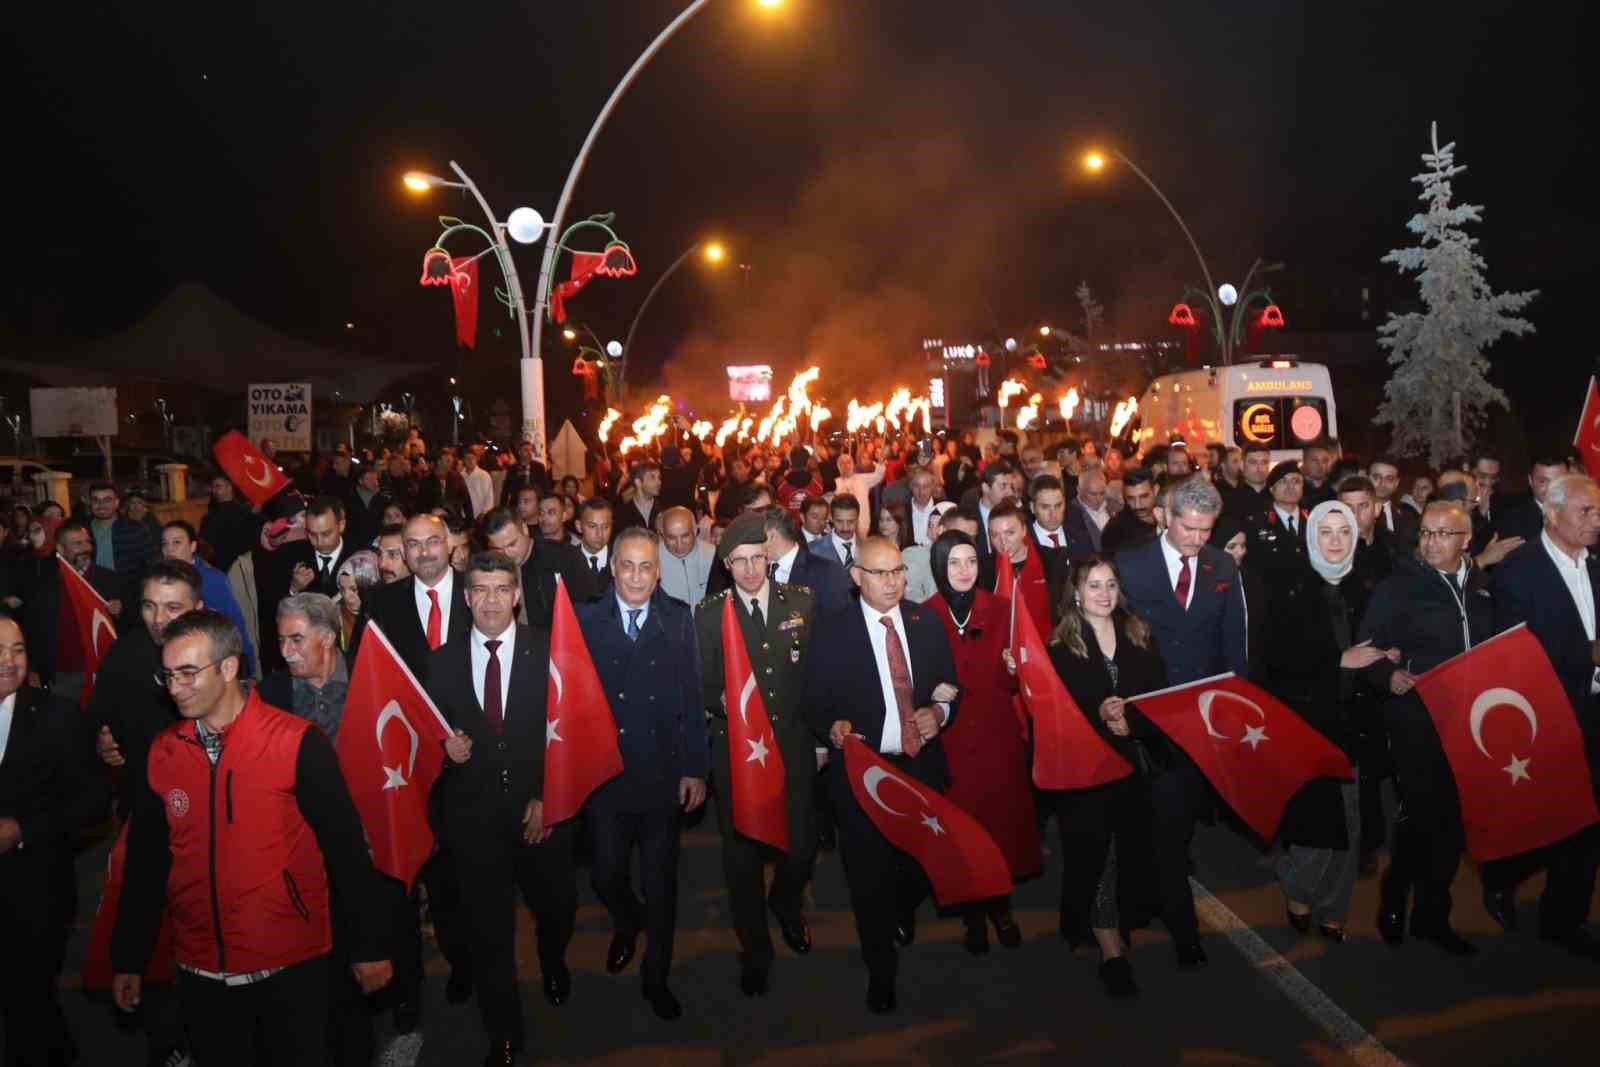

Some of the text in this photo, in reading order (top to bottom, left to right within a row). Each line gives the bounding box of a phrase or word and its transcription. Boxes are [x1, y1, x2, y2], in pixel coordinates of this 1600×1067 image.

[1247, 380, 1312, 392] AMBULANS
[251, 388, 282, 401] OTO
[250, 403, 308, 415] YIKAMA
[251, 418, 282, 432] OTO
